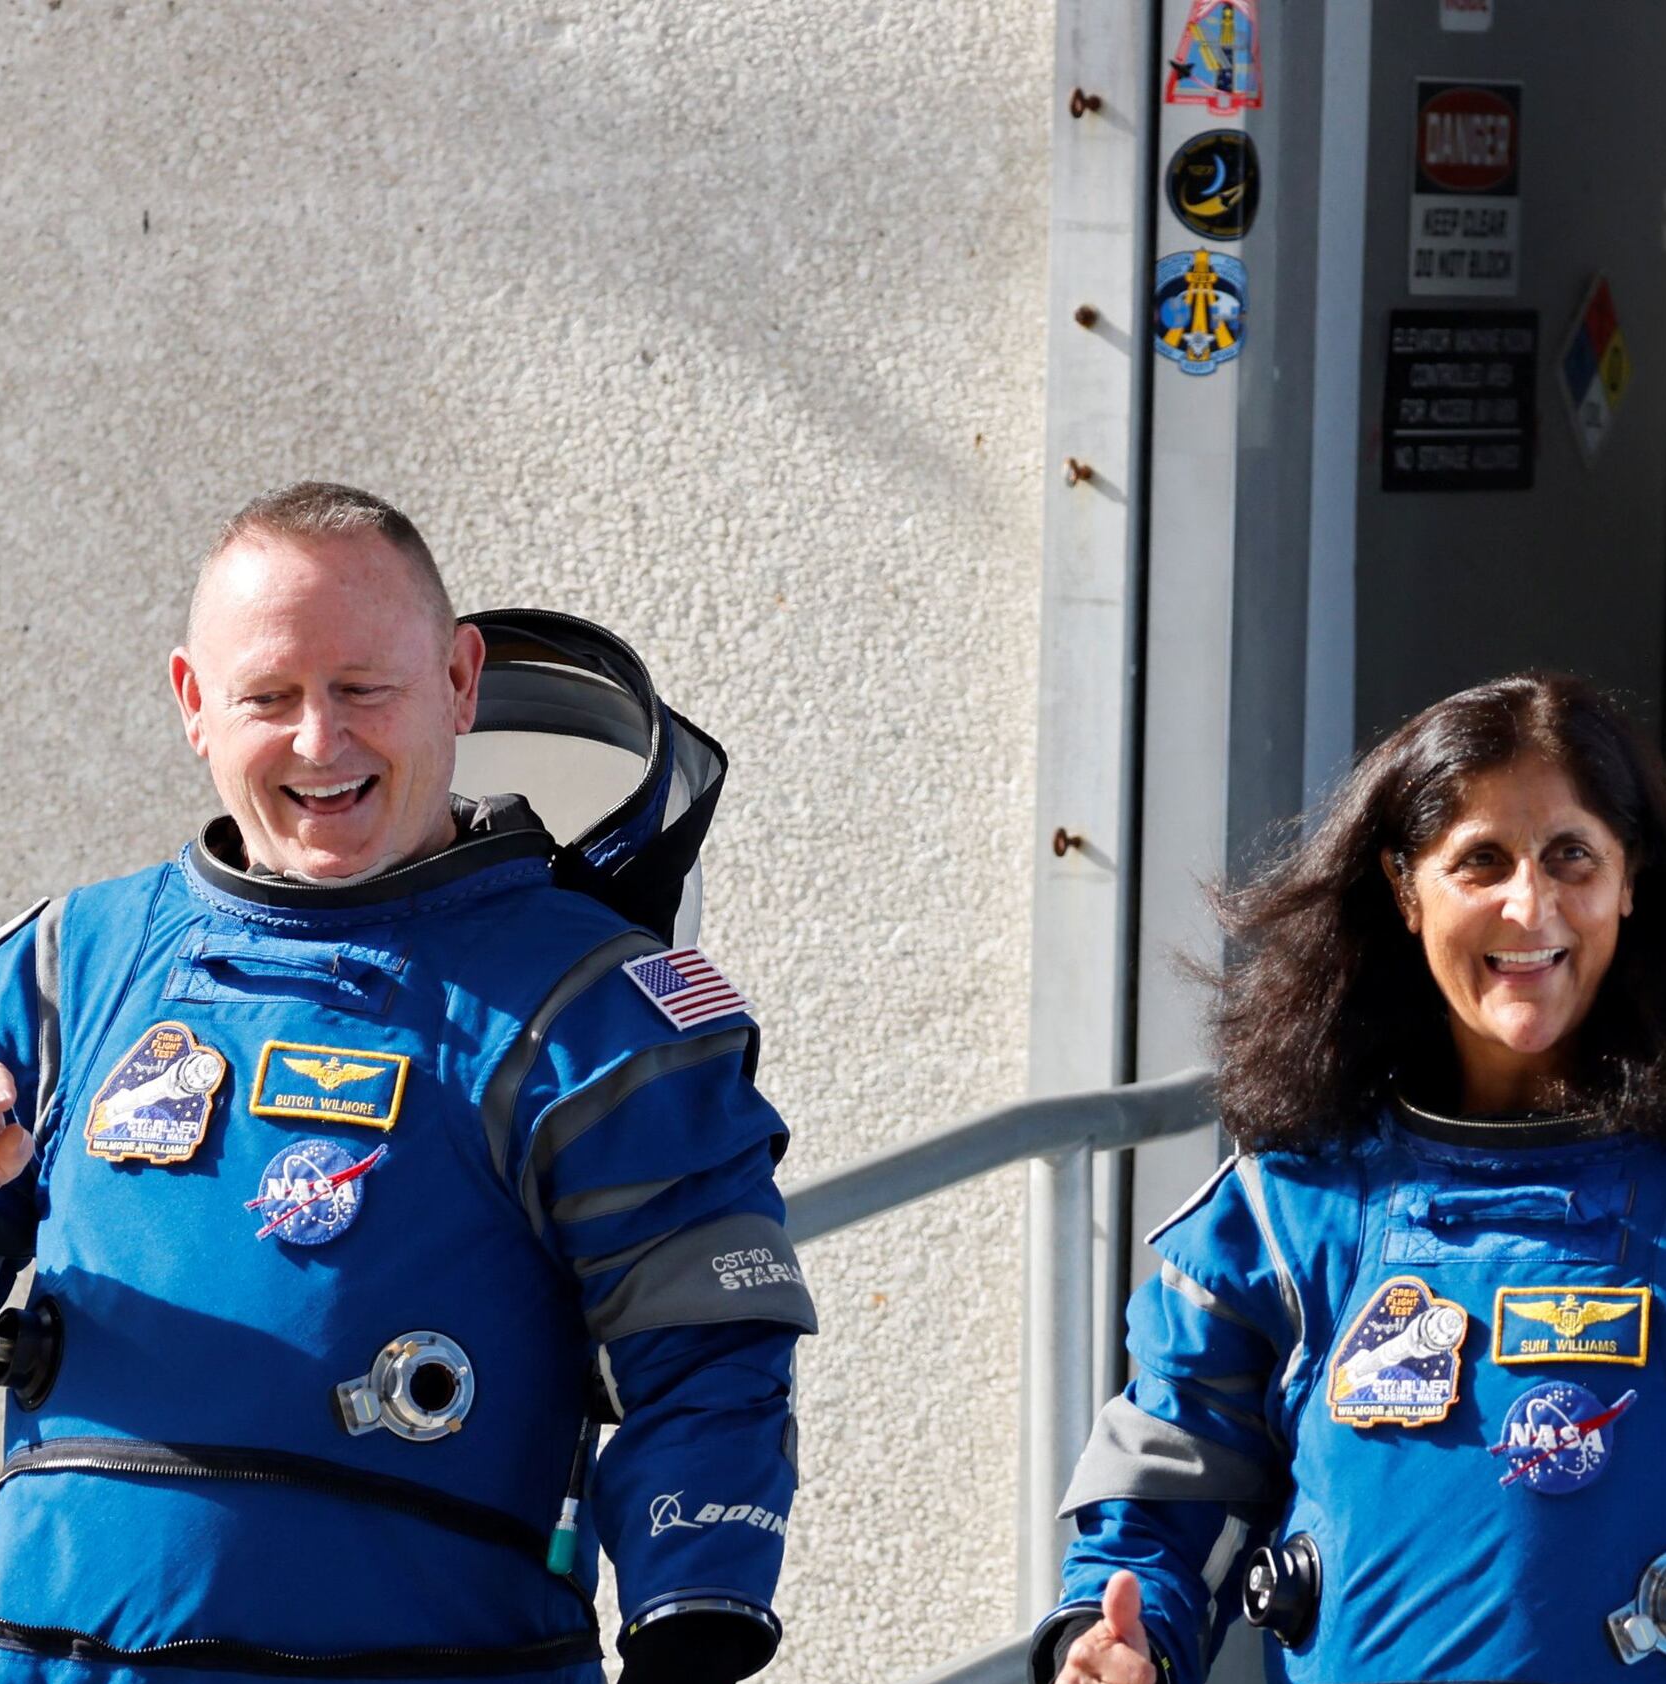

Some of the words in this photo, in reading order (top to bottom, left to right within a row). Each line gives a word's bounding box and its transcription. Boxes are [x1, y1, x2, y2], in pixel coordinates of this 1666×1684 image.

[1426, 112, 1510, 165] DANGER
[1422, 207, 1459, 237] KEEP
[1462, 207, 1508, 238] CLEAR
[156, 1031, 184, 1043] CREW
[151, 1039, 183, 1051] FLIGHT
[153, 1048, 178, 1060] TEST
[275, 1094, 314, 1108] BUTCH
[320, 1097, 376, 1115] WILMORE
[93, 1139, 137, 1152] WILMORE
[143, 1142, 190, 1155] WILLIAMS
[265, 1177, 356, 1205] NASA
[712, 1248, 774, 1272] CST-100
[1390, 1287, 1421, 1298] CREW
[1385, 1295, 1421, 1307] FLIGHT
[1388, 1305, 1414, 1316] TEST
[1520, 1339, 1549, 1353] SUNI
[1556, 1339, 1617, 1353] WILLIAMS
[1371, 1379, 1451, 1395] STARLINER
[1337, 1404, 1385, 1416] WILMORE
[1394, 1404, 1443, 1416] WILLIAMS
[1507, 1422, 1605, 1454] NASA
